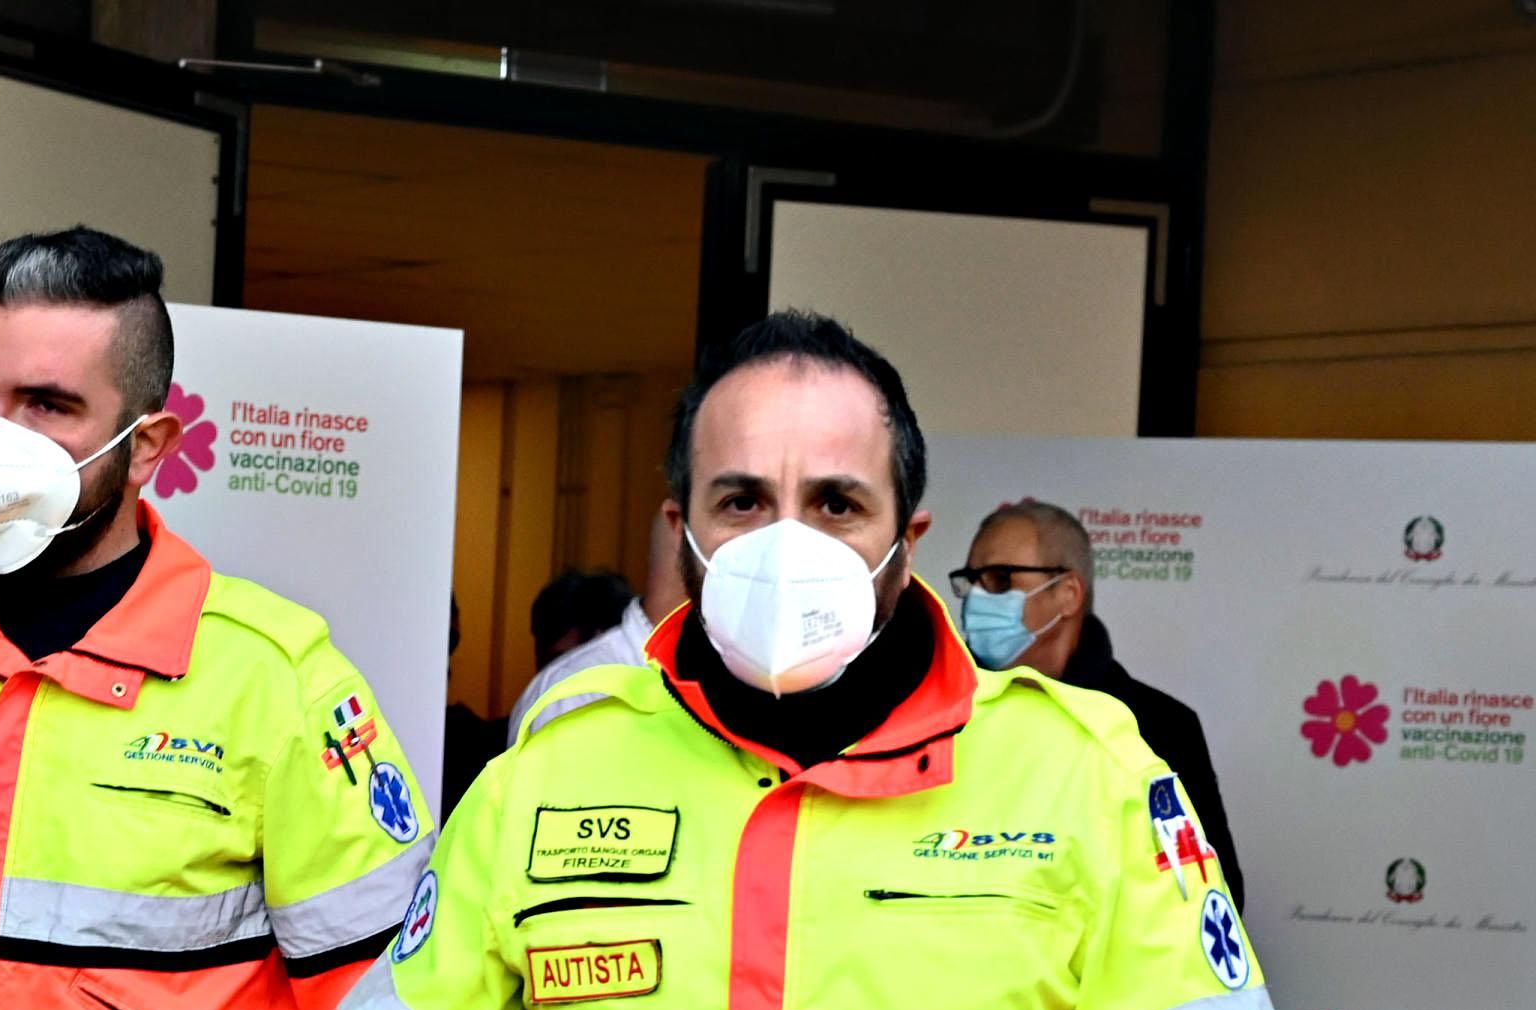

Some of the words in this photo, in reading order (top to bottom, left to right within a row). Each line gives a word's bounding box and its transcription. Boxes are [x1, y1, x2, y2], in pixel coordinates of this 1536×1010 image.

[231, 401, 290, 426] l'Italia
[295, 407, 368, 432] rinasce
[230, 429, 266, 446] con
[272, 433, 295, 449] un
[301, 431, 345, 452] fiore
[229, 451, 360, 476] vaccinazione
[228, 472, 332, 497] anti-Covid
[337, 478, 358, 499] 19
[1135, 509, 1202, 527] rinasce
[1088, 530, 1110, 543] on
[1140, 529, 1180, 544] fiore
[1404, 687, 1458, 705] l'Italia
[1464, 689, 1534, 709] rinasce
[1402, 710, 1435, 723] con
[1440, 711, 1463, 724] un
[1469, 708, 1511, 726] fiore
[1401, 726, 1525, 744] vaccinazione
[1400, 743, 1498, 762] anti-Covid
[1504, 748, 1523, 764] 19
[577, 817, 631, 840] SVS
[563, 857, 632, 869] FIRENZE
[913, 848, 979, 860] GESTIONE
[542, 951, 645, 989] AUTISTA
